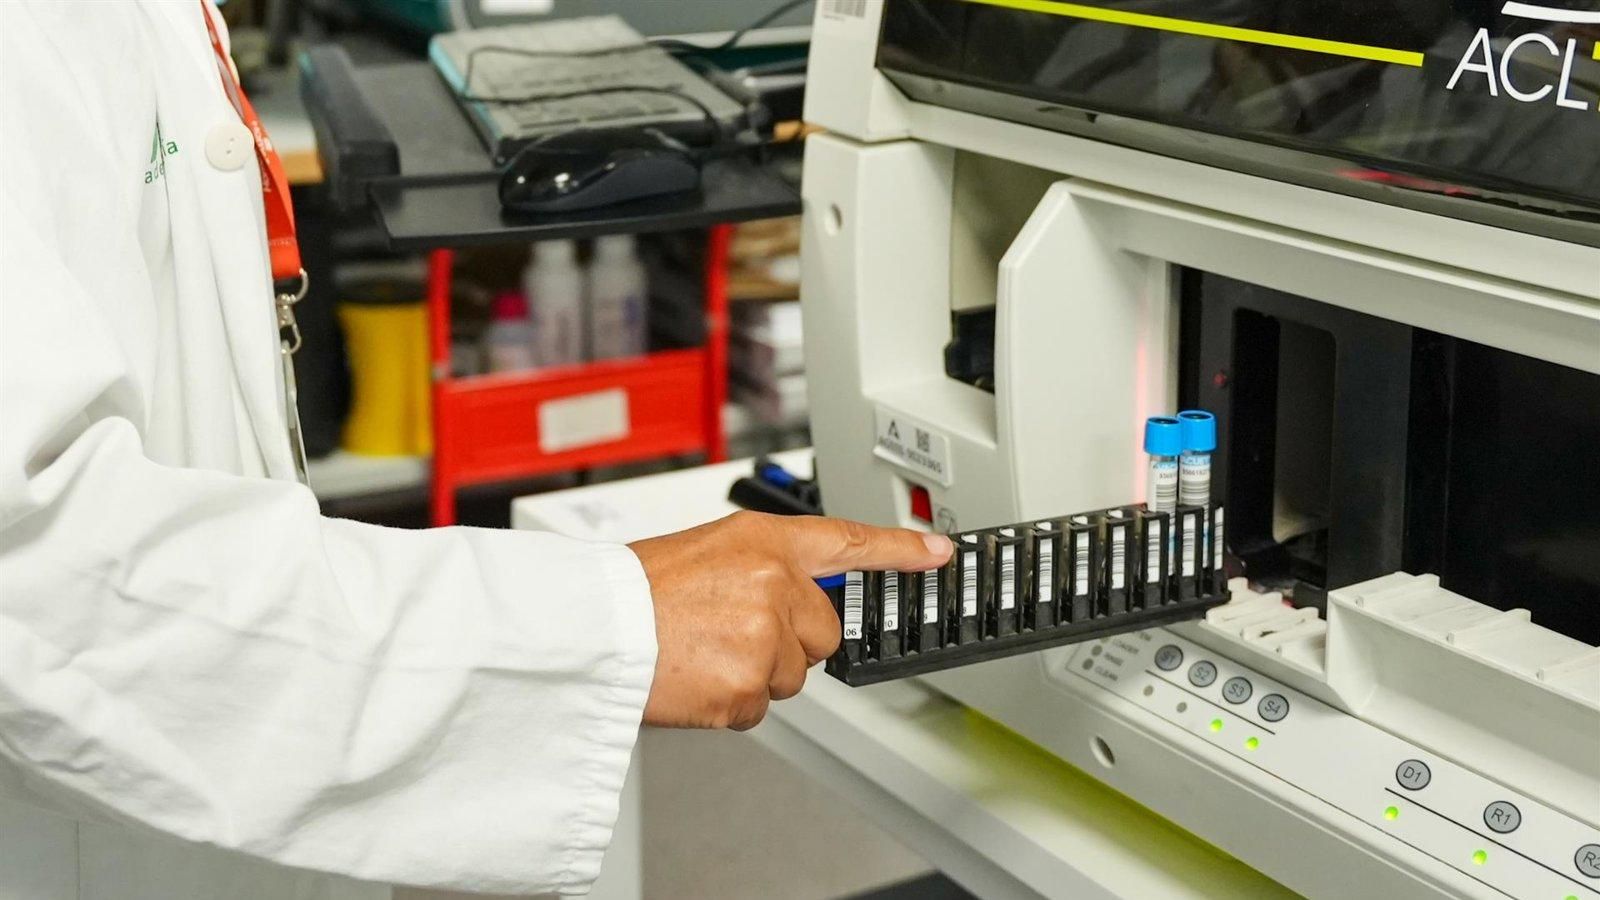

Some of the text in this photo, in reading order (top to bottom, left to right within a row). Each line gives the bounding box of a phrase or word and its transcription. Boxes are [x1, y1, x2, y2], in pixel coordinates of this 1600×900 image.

[1446, 27, 1588, 111] ACL
[845, 628, 857, 637] 06
[1160, 650, 1176, 665] S1
[1194, 666, 1210, 681] S2
[1228, 683, 1245, 698] S3
[1264, 700, 1281, 715] S4
[1403, 766, 1422, 783] D1
[1490, 807, 1512, 826] R1
